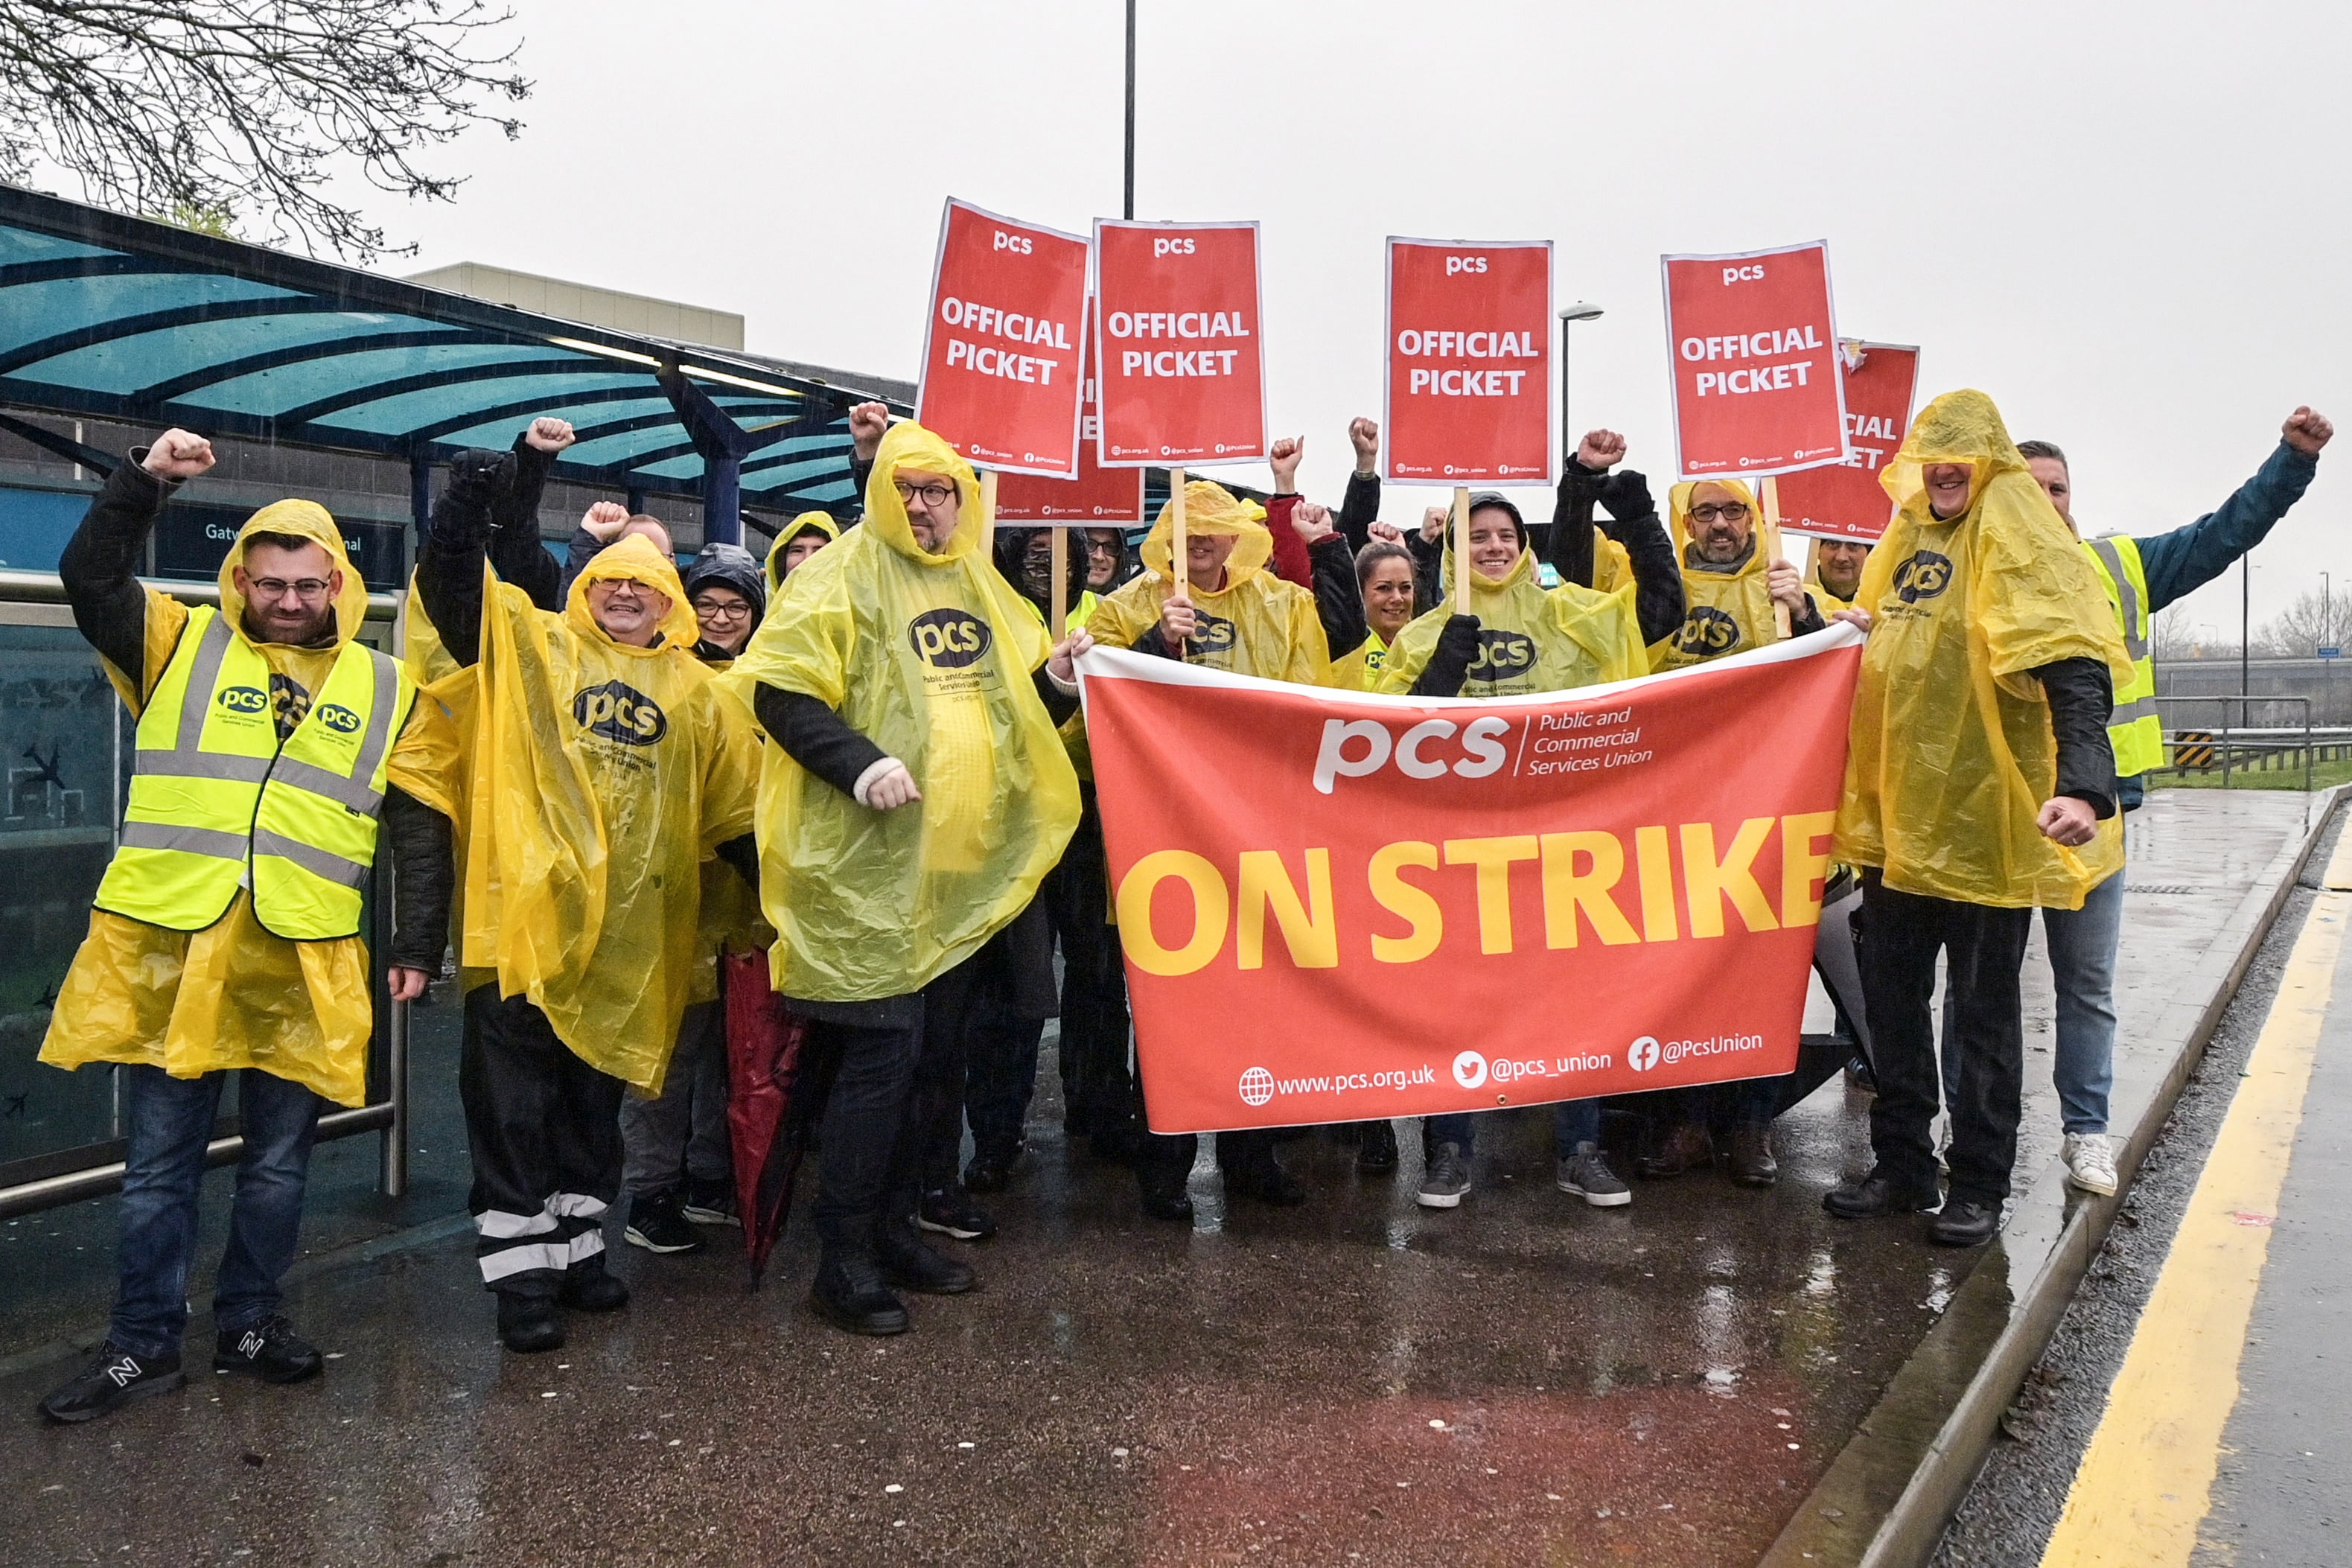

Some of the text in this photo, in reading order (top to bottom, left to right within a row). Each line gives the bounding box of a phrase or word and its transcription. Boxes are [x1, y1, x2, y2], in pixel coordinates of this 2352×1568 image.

[993, 230, 1033, 255] pcs
[1153, 238, 1196, 258] pcs
[1446, 255, 1488, 276] pcs
[1722, 264, 1765, 286] pcs
[941, 297, 1071, 350] OFFICIAL
[1108, 311, 1249, 338] OFFICIAL
[1398, 329, 1539, 357] OFFICIAL
[1680, 325, 1823, 361] OFFICIAL
[946, 339, 1058, 385] PICKET
[1122, 349, 1238, 377] PICKET
[1409, 369, 1526, 396] PICKET
[1696, 360, 1812, 396] PICKET
[205, 523, 240, 541] Gatw
[914, 621, 980, 662] pcs
[223, 690, 265, 709] pcs
[322, 707, 357, 730] pcs
[585, 692, 657, 736] pcs
[1540, 707, 1632, 731] Public and
[1534, 727, 1640, 754] Commercial
[1313, 716, 1510, 794] pcs
[1527, 749, 1653, 777] Services Union
[1115, 810, 1838, 976] ON STRIKE
[1277, 1033, 1762, 1094] www.pcs.org.uk @pcs_union @PcsUnion
